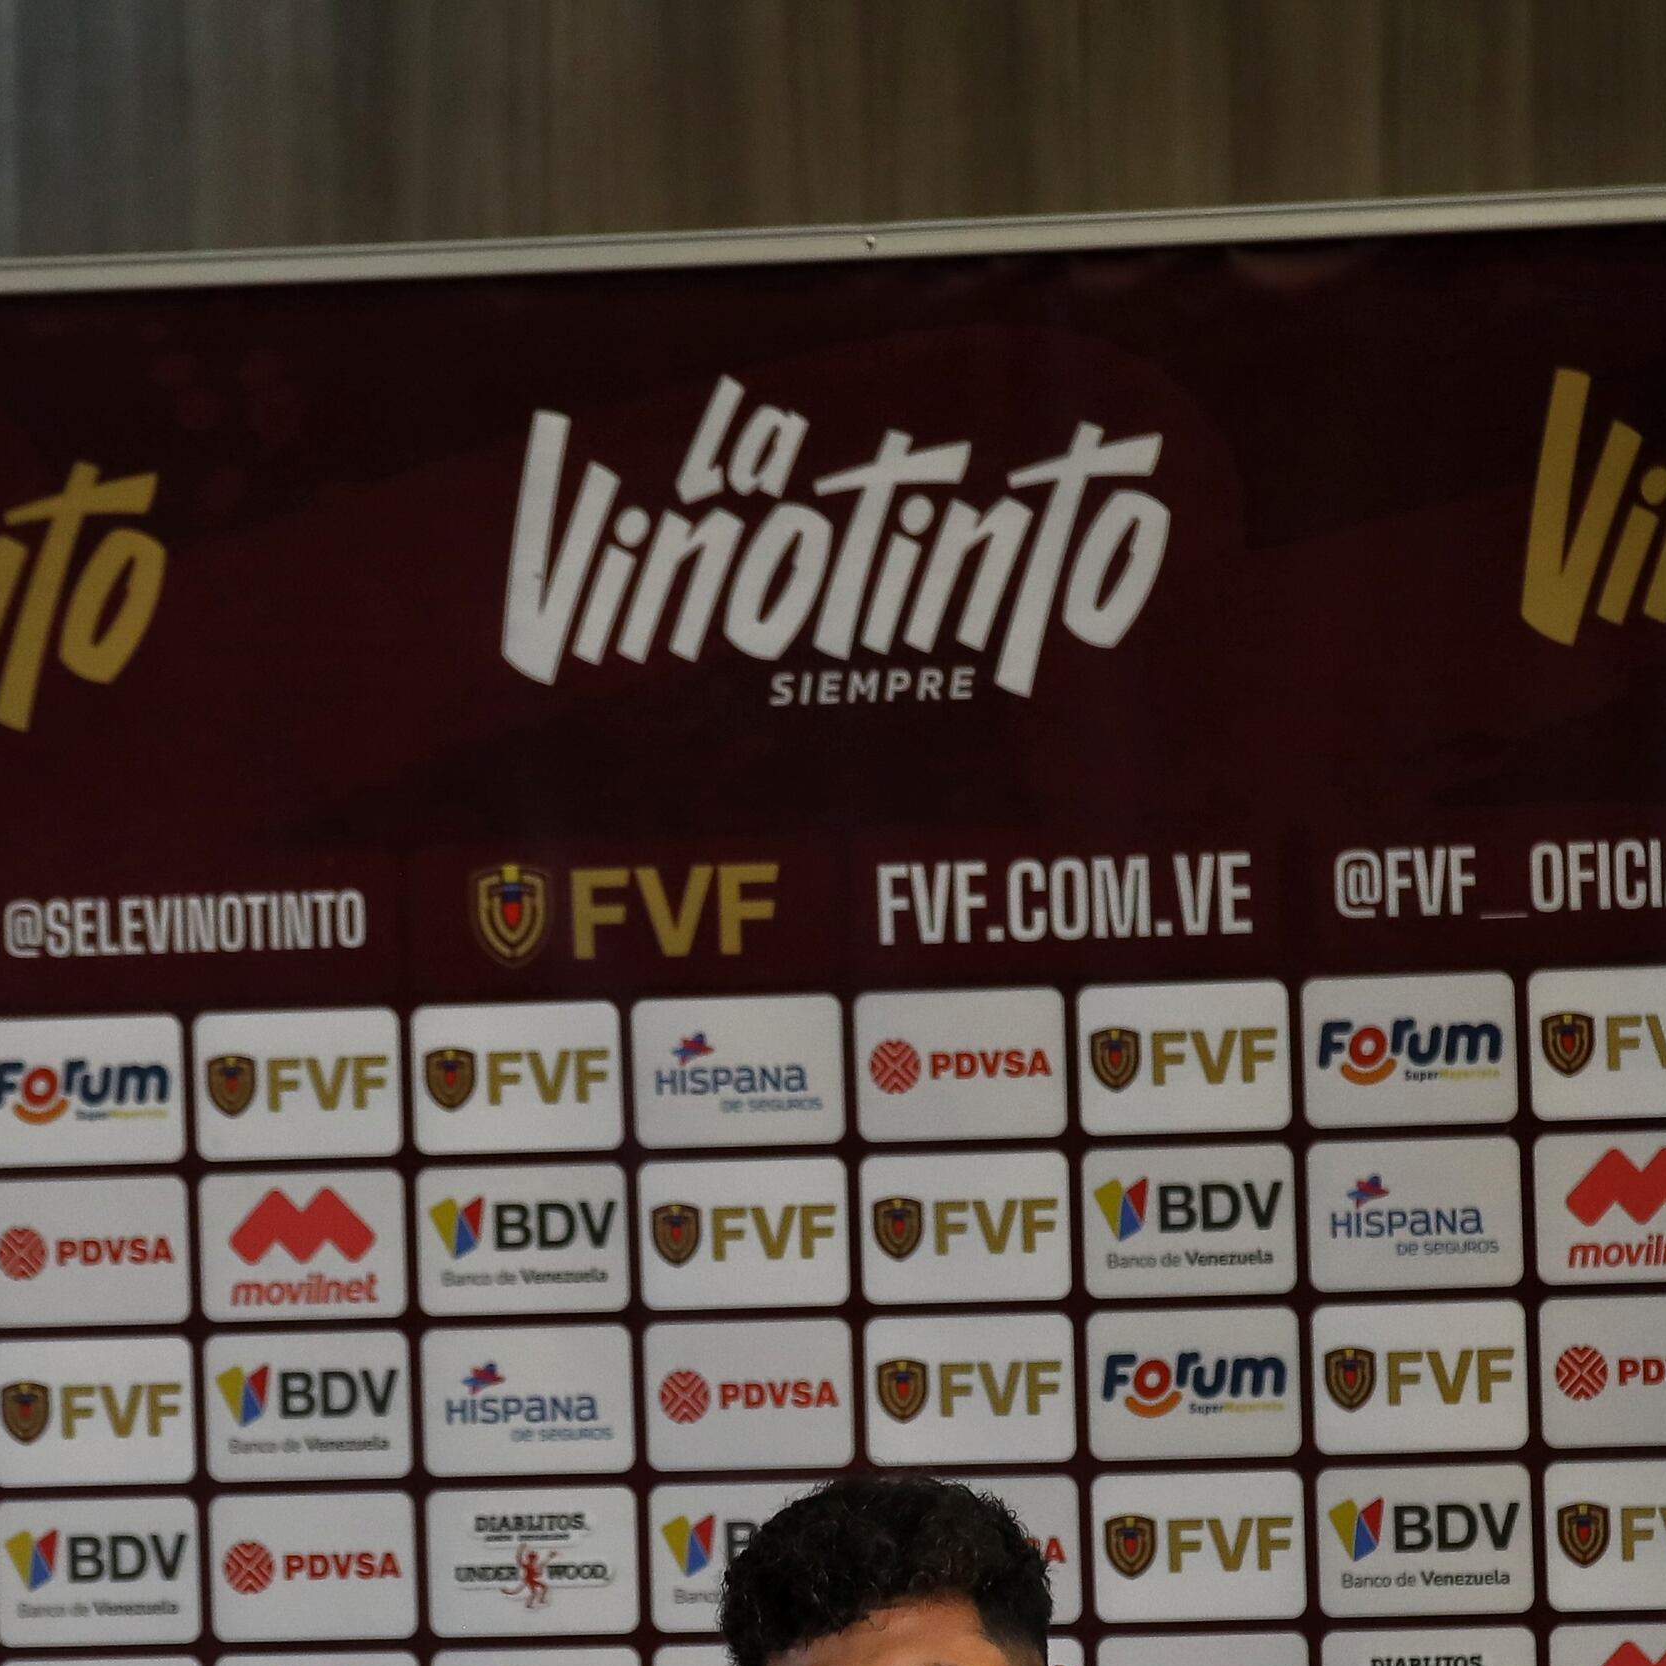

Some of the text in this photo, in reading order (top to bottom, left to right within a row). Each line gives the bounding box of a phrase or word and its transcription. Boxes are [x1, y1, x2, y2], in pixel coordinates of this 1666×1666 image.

[675, 373, 810, 506] La
[500, 409, 1171, 700] Vinotinto
[770, 666, 975, 706] SIEMPRE
[4, 889, 365, 958] @SELEVINOTINTO
[571, 863, 779, 959] FVF
[877, 852, 1252, 945] FVF.COM.VE
[929, 1049, 1052, 1079] PDVSA
[1150, 1027, 1278, 1086] FVF
[1317, 1014, 1505, 1069] Forum
[266, 1055, 388, 1112] FVF
[486, 1048, 610, 1105] FVF
[494, 1200, 616, 1251] BDV
[711, 1203, 836, 1261] FVF
[933, 1198, 1058, 1255] FVF
[1158, 1181, 1283, 1233] BDV
[56, 1236, 174, 1266] PDVSA
[1105, 1247, 1275, 1270] Banco de Venezuela
[231, 1272, 378, 1306] movilnet
[279, 1369, 398, 1419] BDV
[719, 1380, 839, 1409] PDVSA
[938, 1360, 1062, 1417] FVF
[1102, 1350, 1289, 1402] Forum
[1386, 1347, 1515, 1406] FVF
[60, 1382, 182, 1439] FVF
[474, 1513, 587, 1533] DIABLITOS
[1167, 1516, 1293, 1573] FVF
[1393, 1502, 1520, 1553] BDV
[67, 1533, 187, 1583] BDV
[283, 1552, 401, 1580] PDVSA
[1341, 1568, 1511, 1590] Banco de Venezuela
